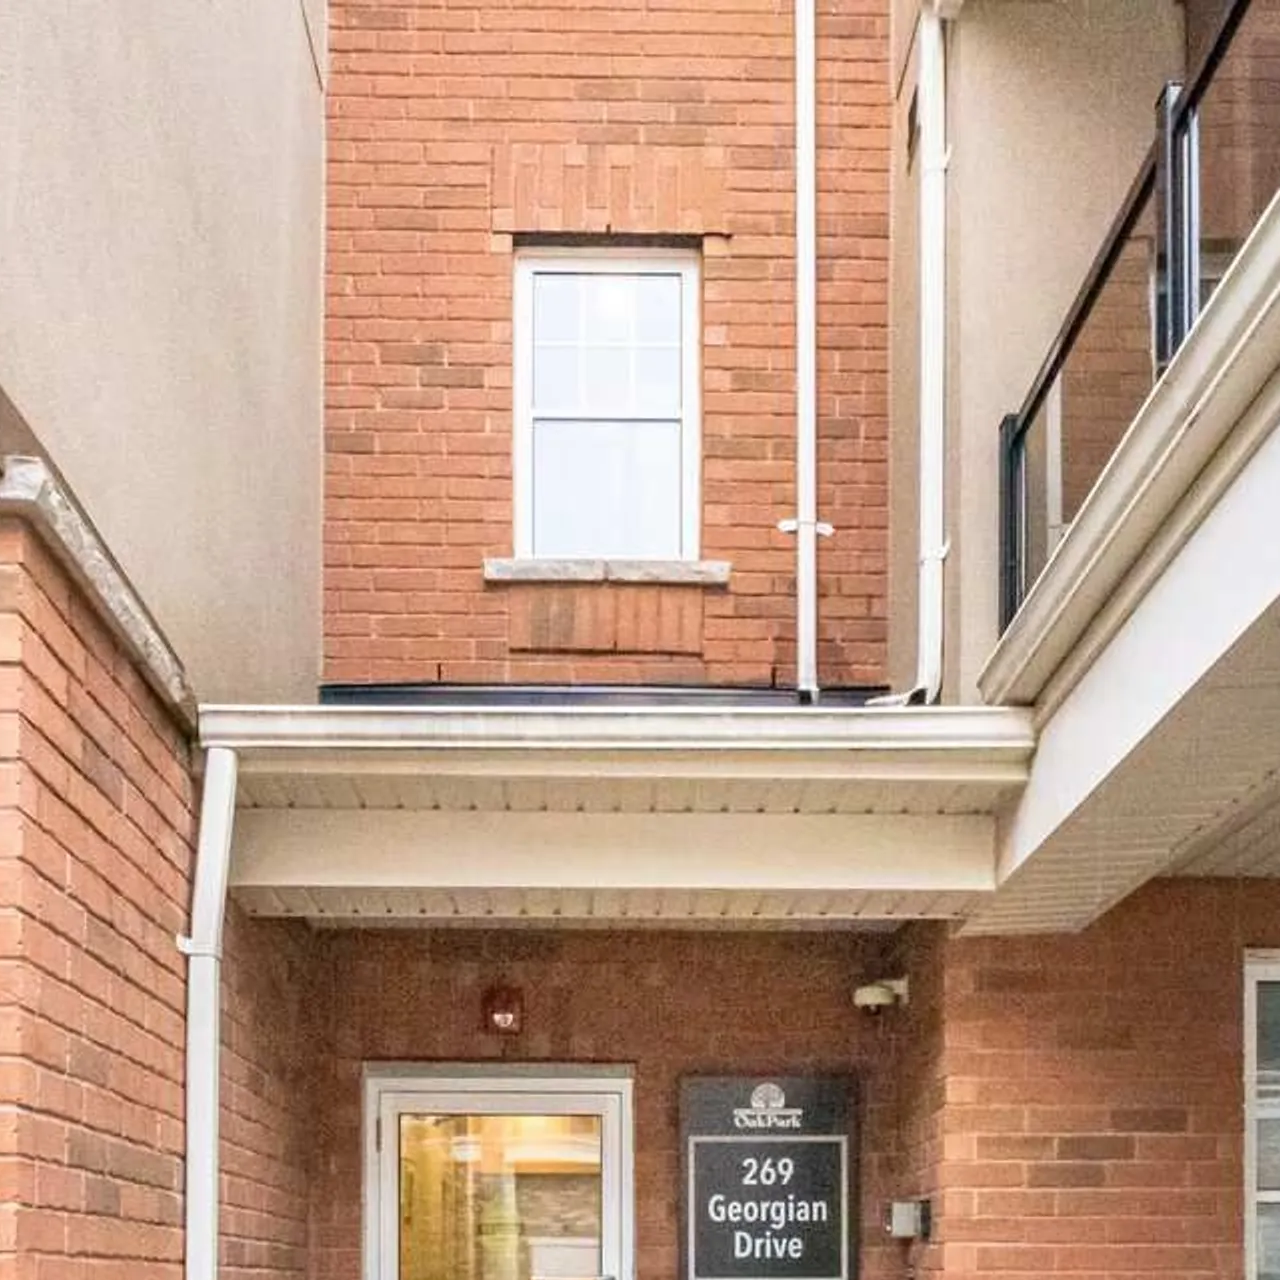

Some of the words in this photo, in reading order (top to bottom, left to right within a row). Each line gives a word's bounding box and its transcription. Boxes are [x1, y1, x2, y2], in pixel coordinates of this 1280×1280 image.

[742, 1158, 794, 1185] 269
[708, 1194, 827, 1229] Georgian
[734, 1232, 803, 1258] Drive
